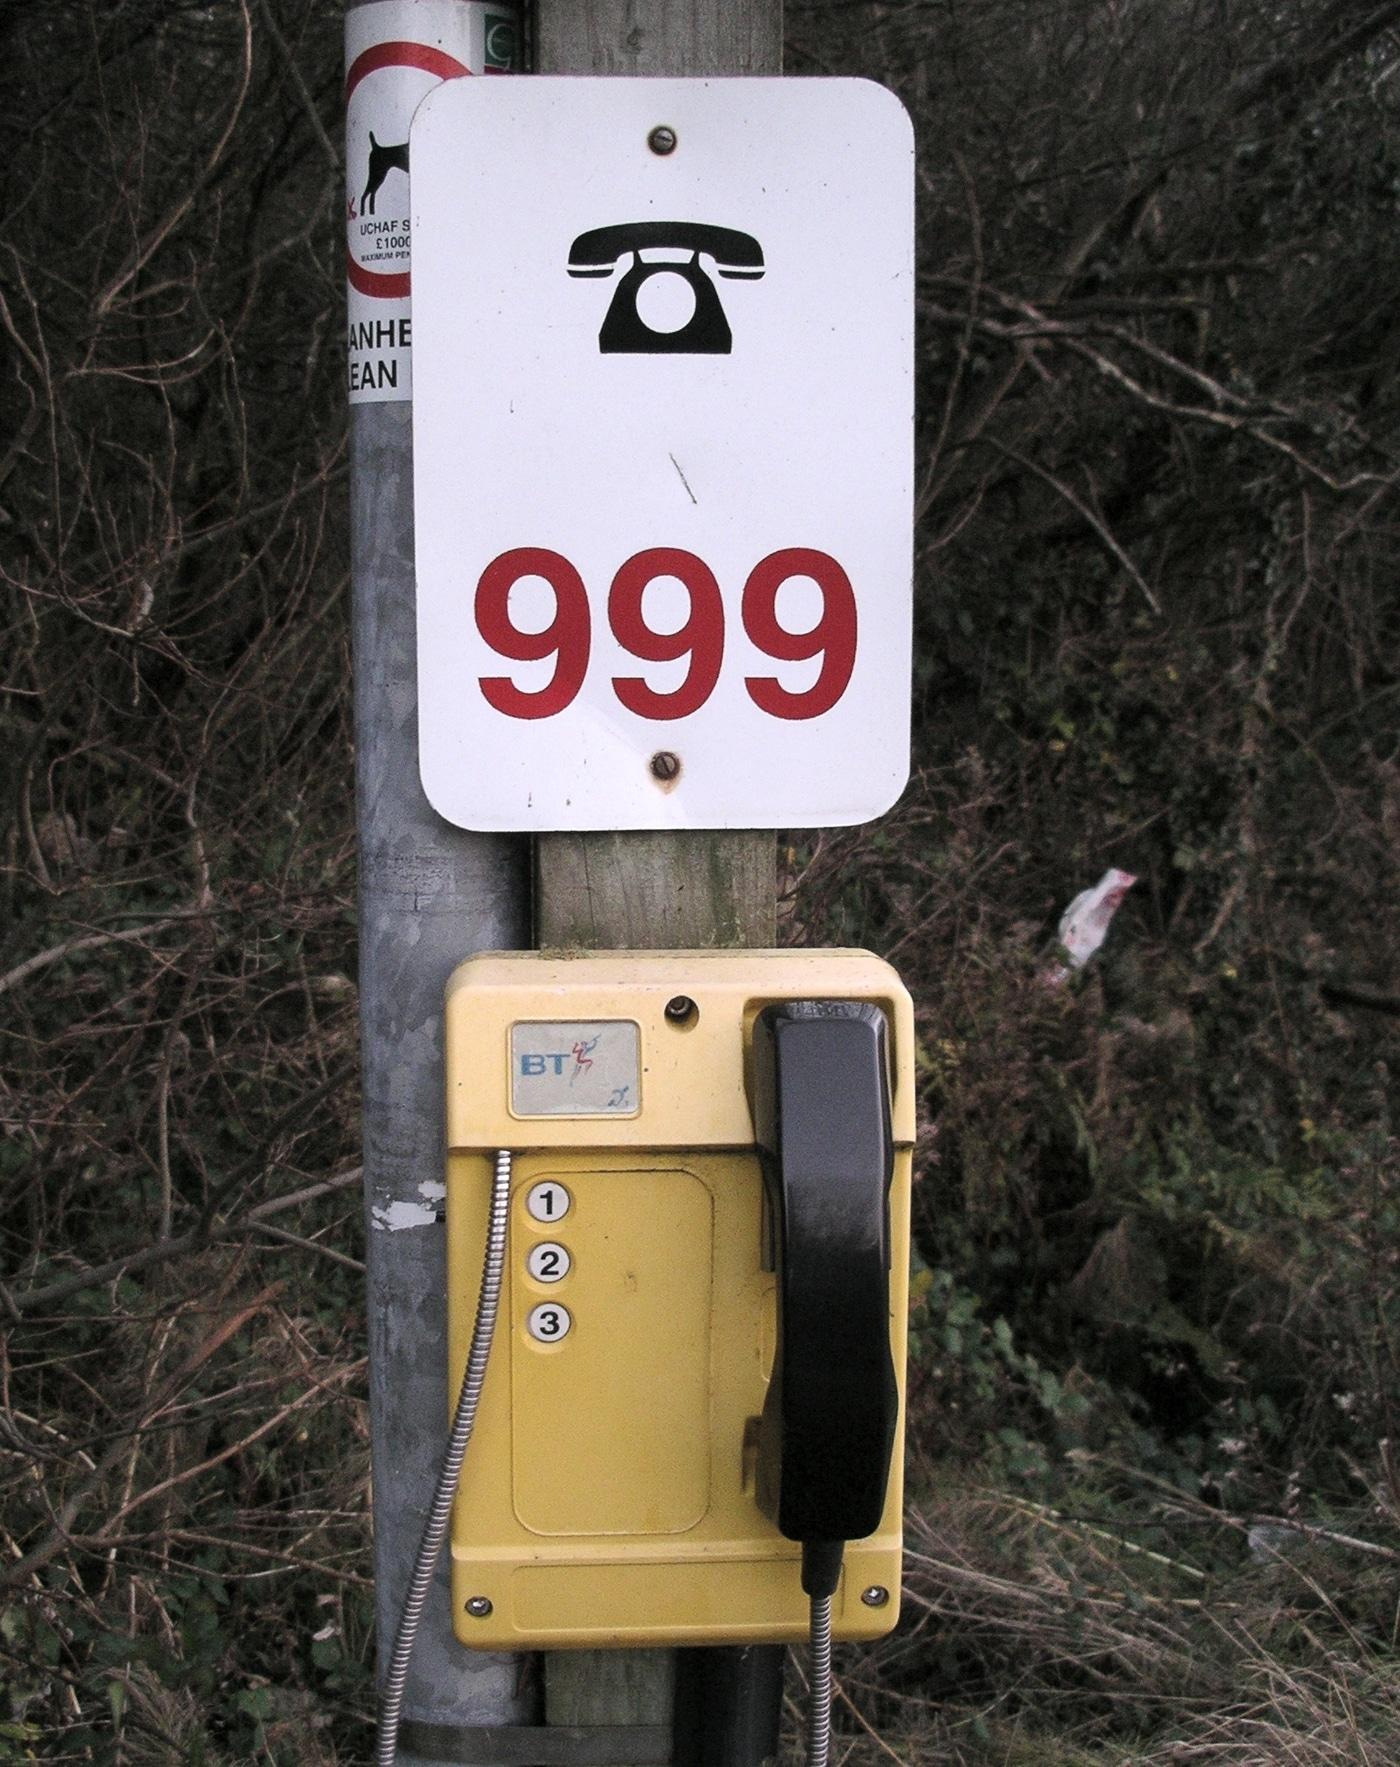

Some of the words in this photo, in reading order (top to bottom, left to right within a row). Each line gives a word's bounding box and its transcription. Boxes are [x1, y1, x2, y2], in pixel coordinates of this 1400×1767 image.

[360, 220, 398, 235] UCHAF
[360, 252, 393, 262] MAXIMUM
[348, 359, 397, 392] EAN
[474, 547, 858, 720] 999
[521, 1054, 571, 1076] BT
[539, 1190, 553, 1215] 1
[540, 1250, 560, 1276] 2
[539, 1311, 560, 1335] 3
